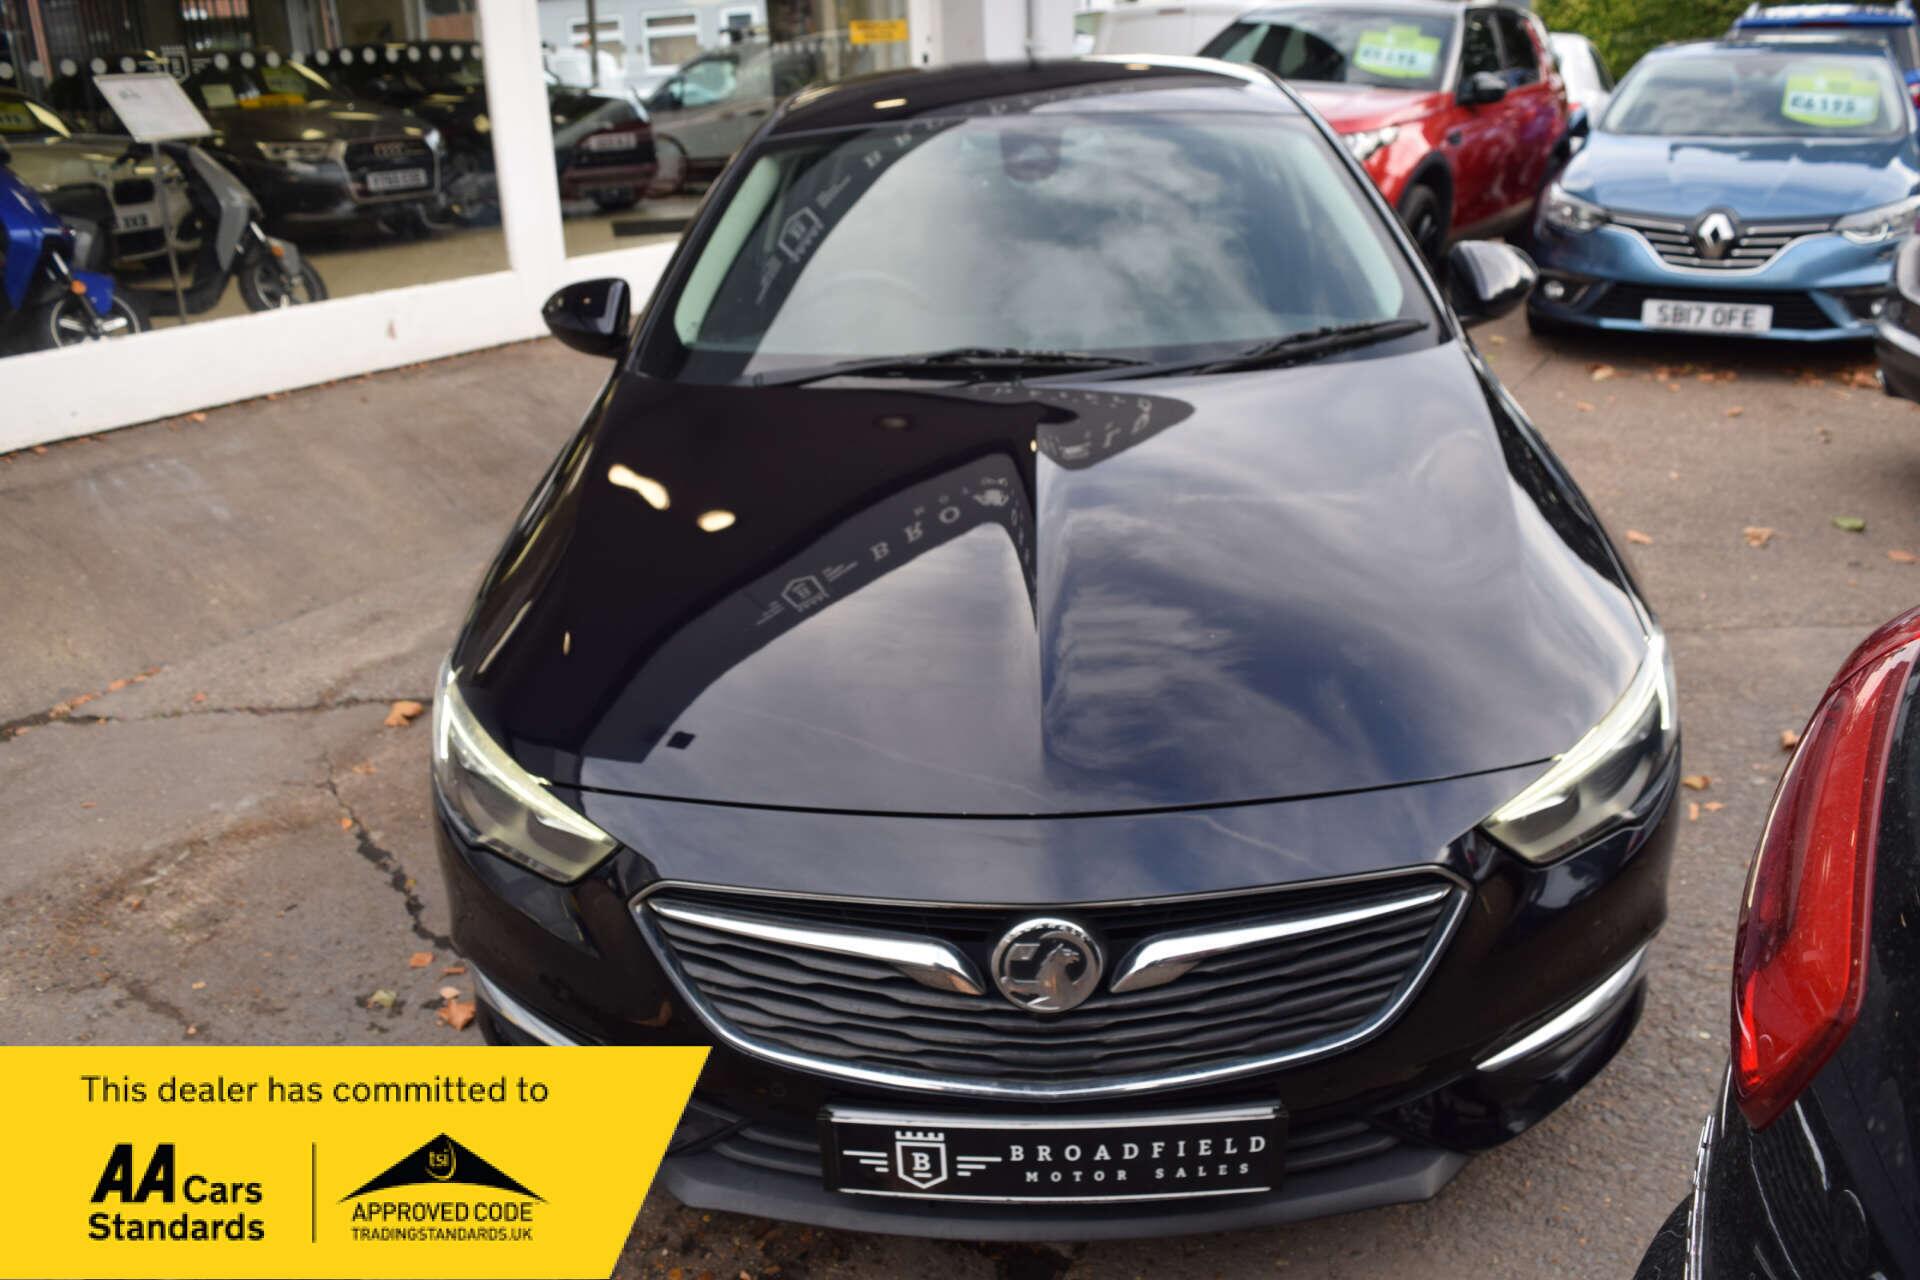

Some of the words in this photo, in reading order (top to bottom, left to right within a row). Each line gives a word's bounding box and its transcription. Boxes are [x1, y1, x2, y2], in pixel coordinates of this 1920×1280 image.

[1657, 303, 1706, 325] SB17
[1711, 306, 1756, 328] OFE
[1010, 1136, 1267, 1162] BROADFIELD
[912, 1152, 931, 1172] B
[1025, 1170, 1128, 1183] MOTOR
[1154, 1163, 1249, 1180] SALES
